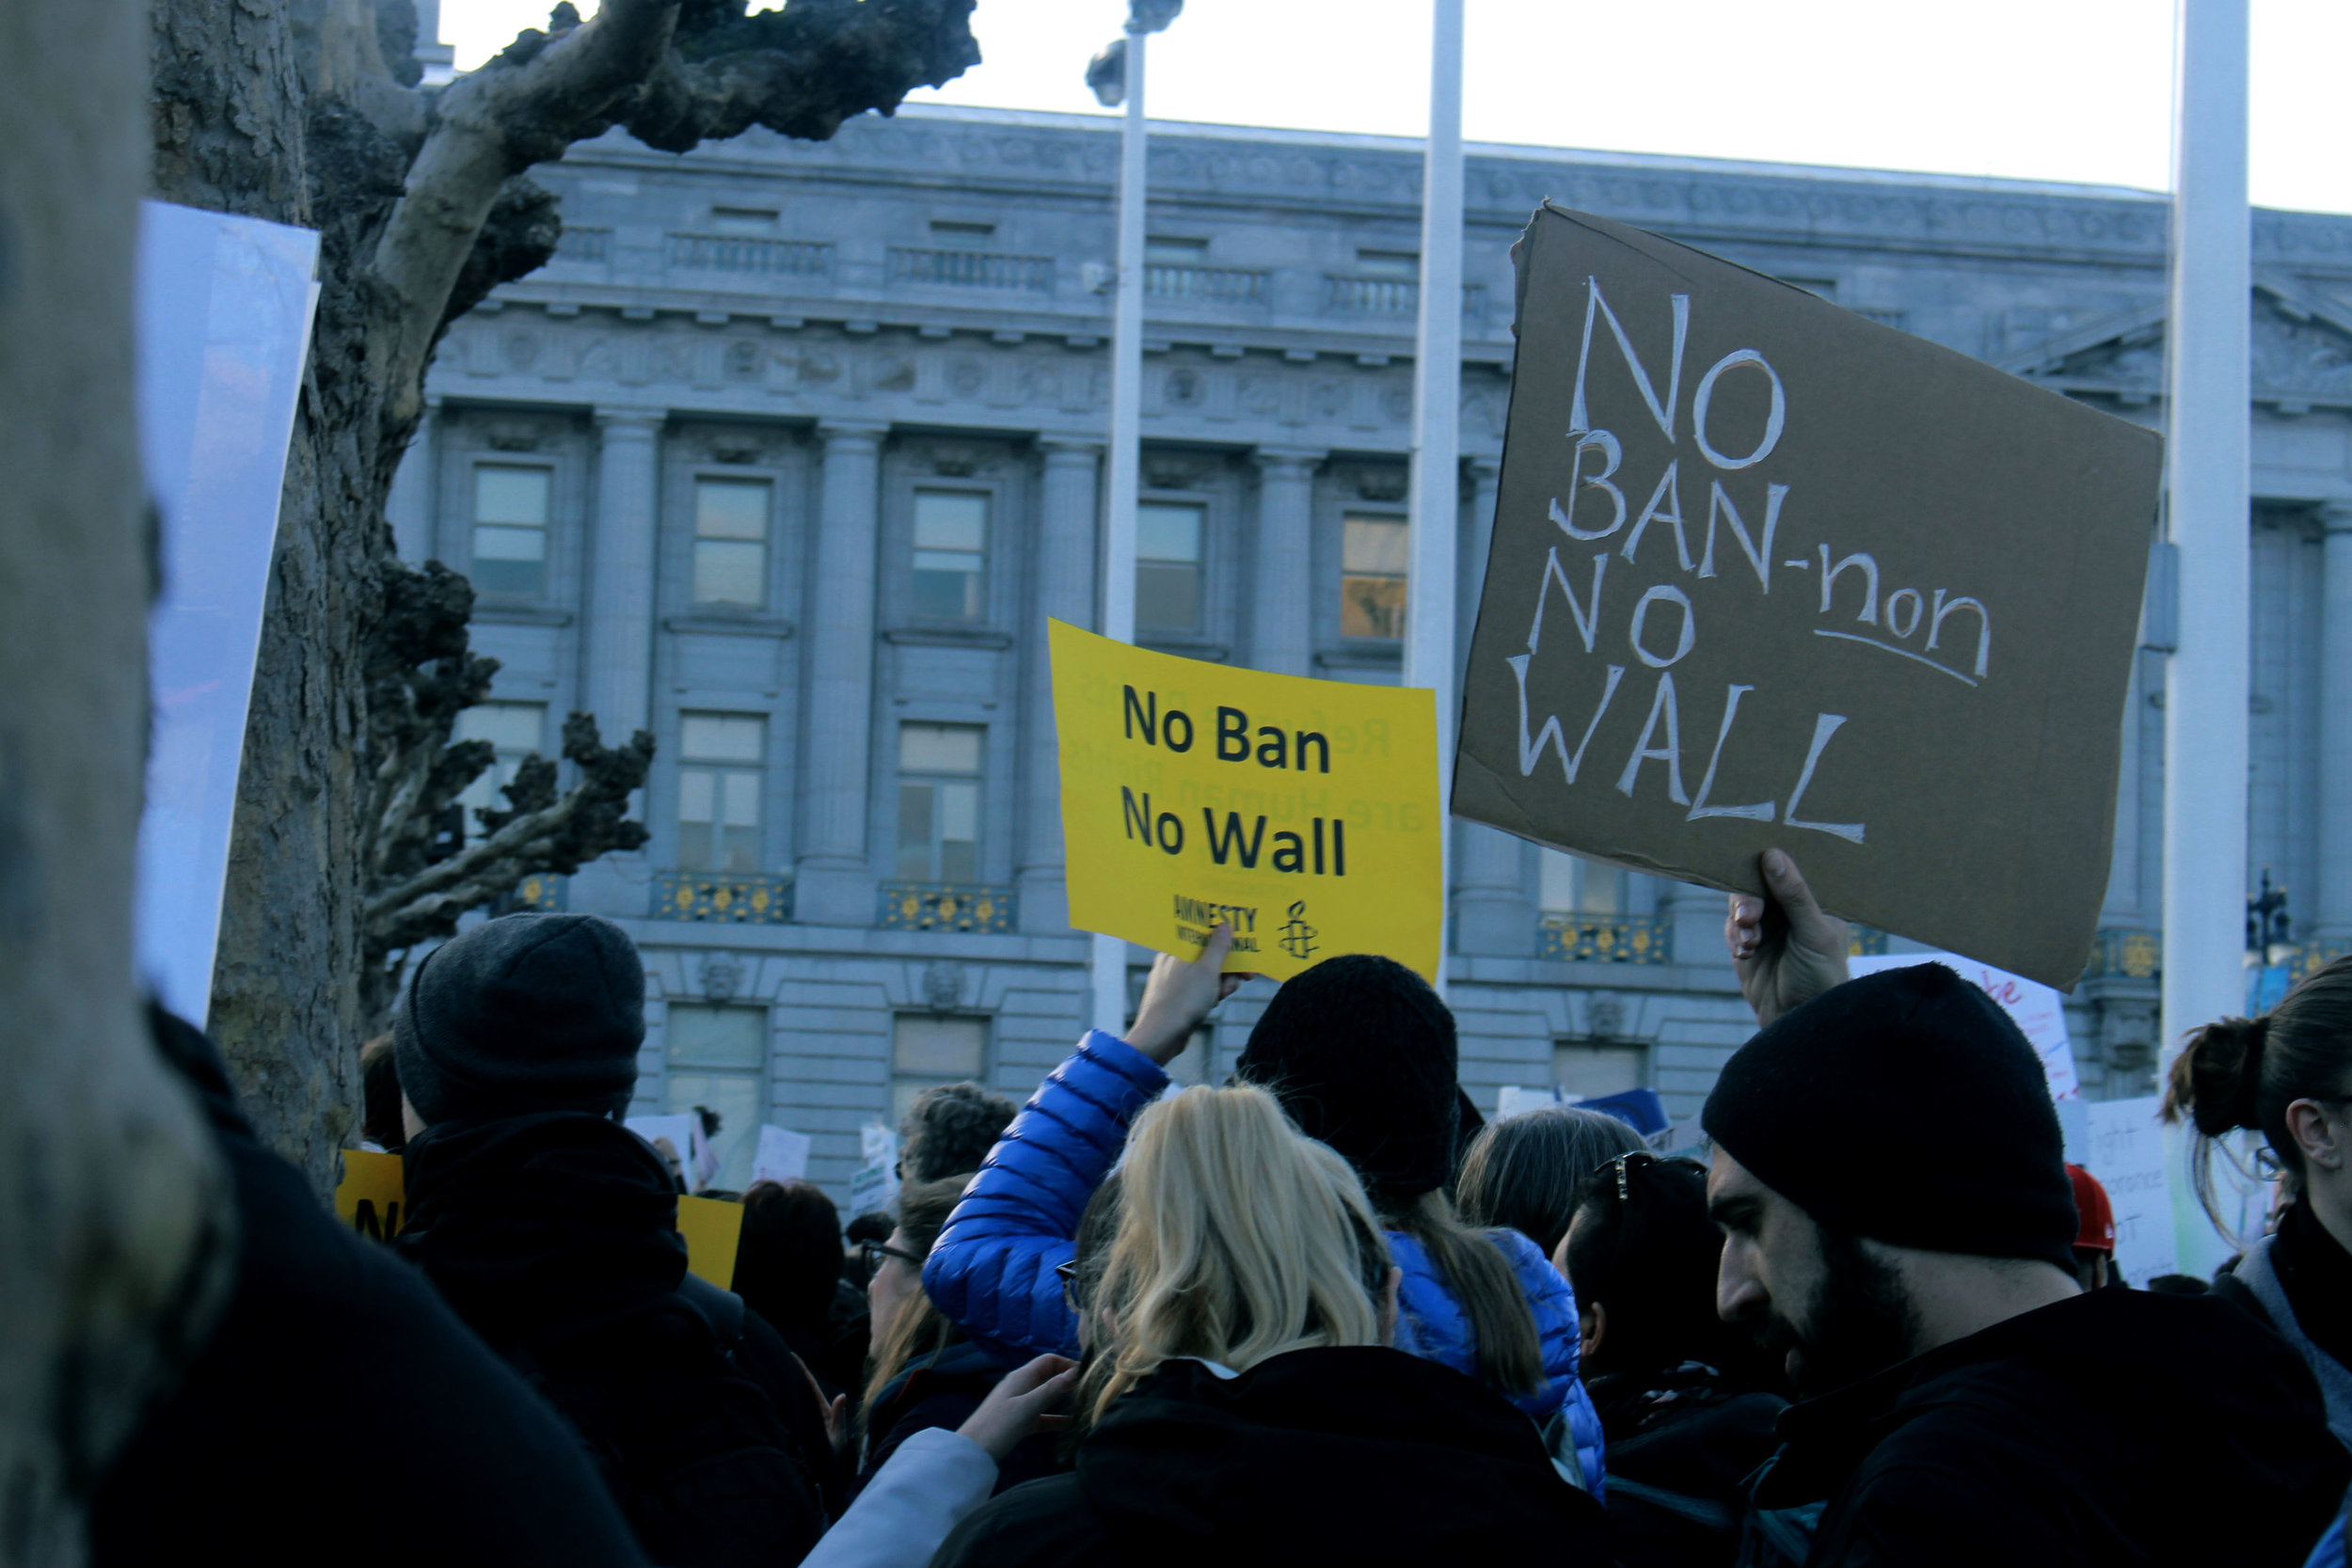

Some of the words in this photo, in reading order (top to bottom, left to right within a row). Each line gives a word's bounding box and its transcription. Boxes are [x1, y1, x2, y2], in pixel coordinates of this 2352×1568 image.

[1565, 276, 1787, 470] NO
[1527, 547, 1694, 668] NO
[1549, 430, 1992, 679] BAN-non
[1122, 684, 1194, 753] No
[1216, 705, 1330, 774] Ban
[1505, 654, 1866, 845] WALL
[1121, 785, 1184, 856] No
[1202, 806, 1345, 878] Wall
[1174, 895, 1258, 932] AMNESTY
